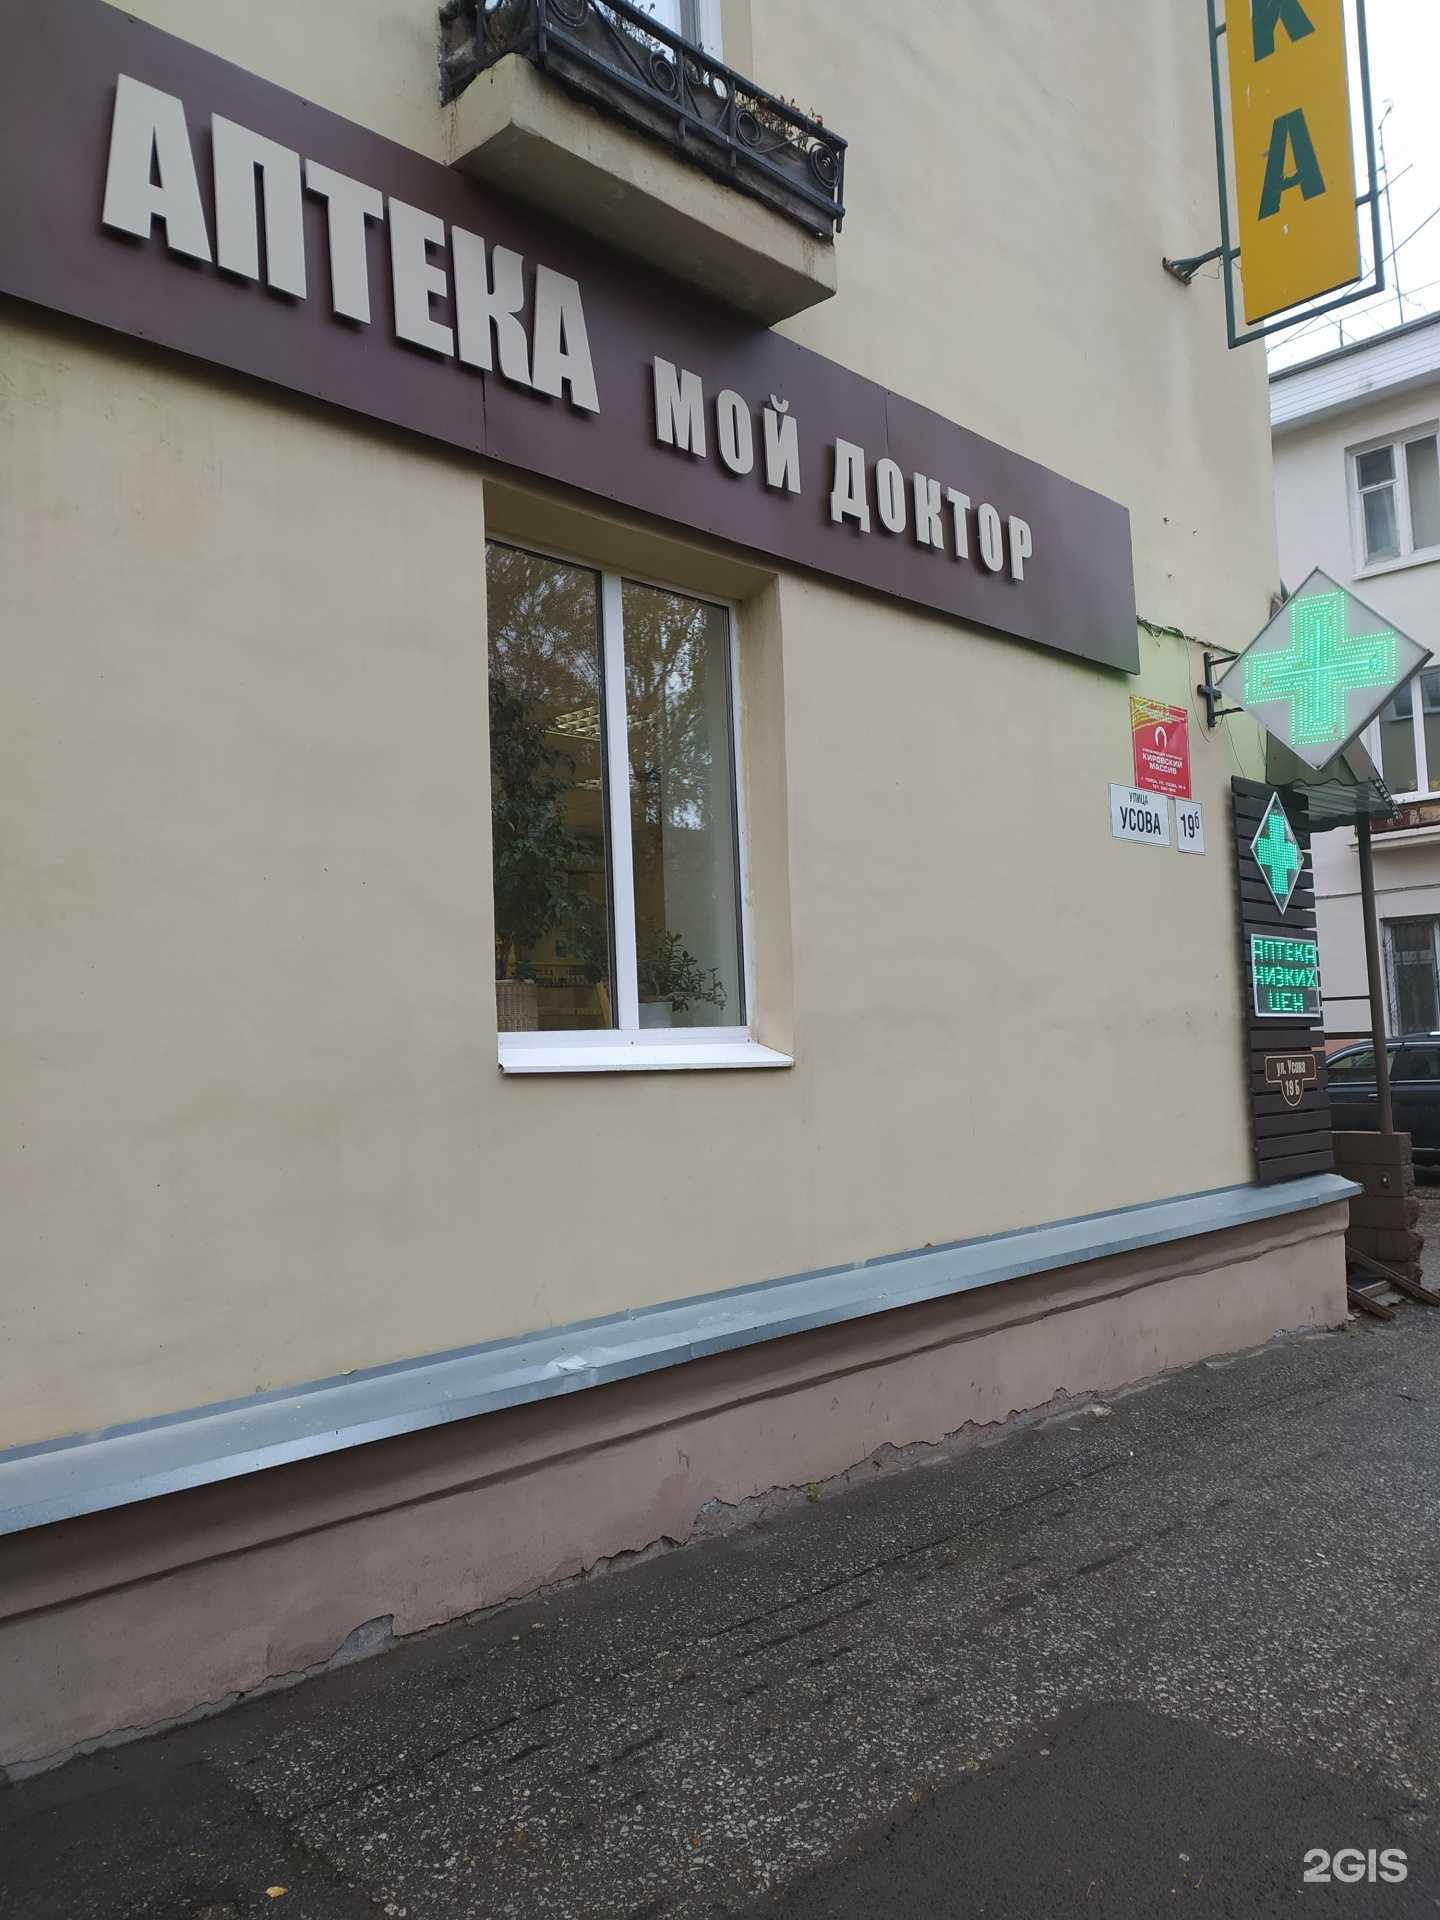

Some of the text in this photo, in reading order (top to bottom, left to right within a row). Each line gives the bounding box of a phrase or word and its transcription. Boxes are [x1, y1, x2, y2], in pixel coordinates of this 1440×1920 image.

[102, 73, 1033, 582] АПТЕКА МОЙ ДОКТОР
[1149, 762, 1177, 775] МАССИВ
[1129, 791, 1149, 805] УЛИЦА
[1120, 806, 1161, 835] УСОВА
[1253, 939, 1316, 964] АПТЕКА
[1253, 966, 1316, 987] НИЗКИХ
[1267, 991, 1304, 1013] ЦЕН
[1287, 1060, 1306, 1074] Усова
